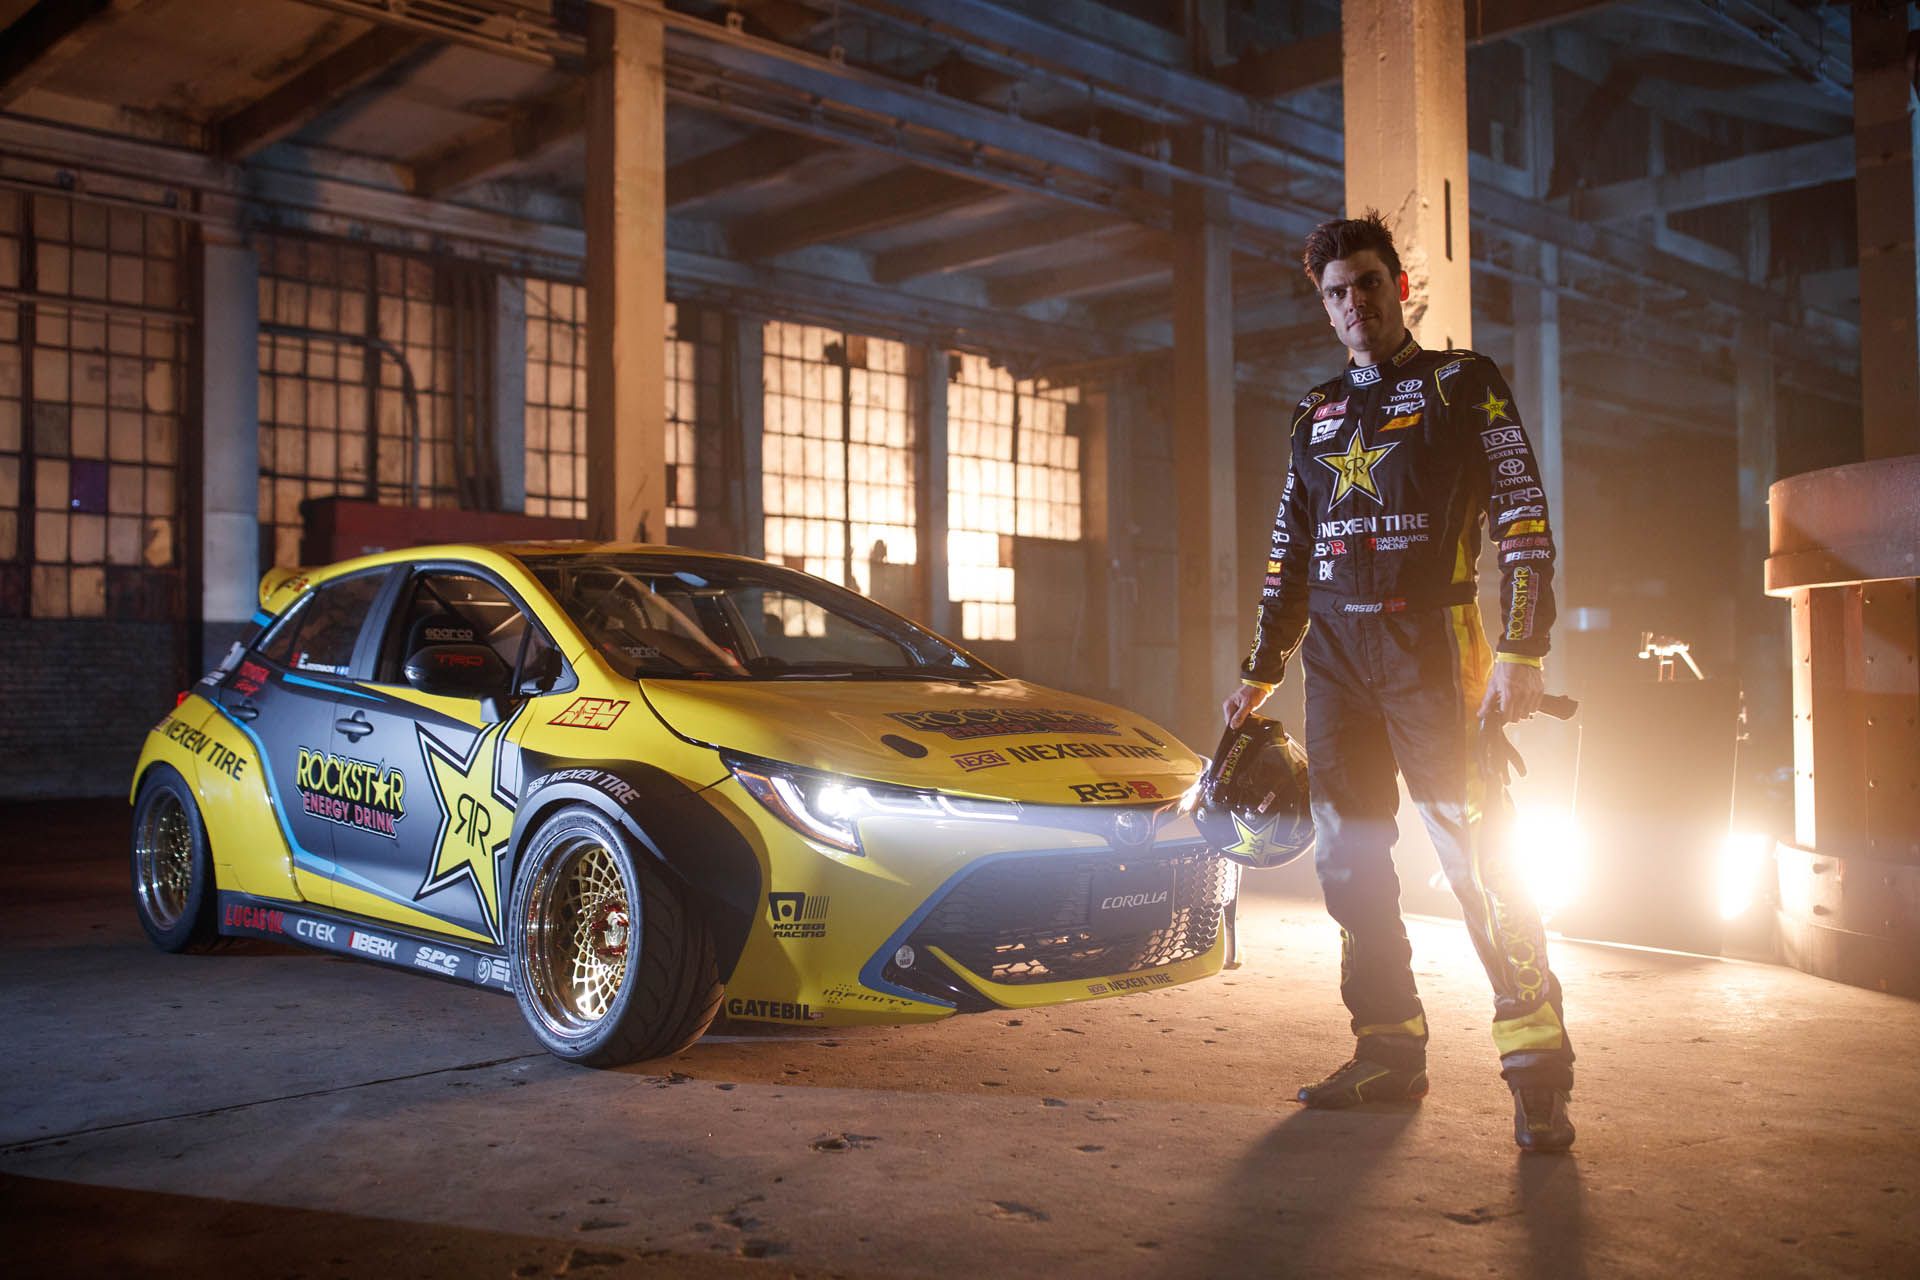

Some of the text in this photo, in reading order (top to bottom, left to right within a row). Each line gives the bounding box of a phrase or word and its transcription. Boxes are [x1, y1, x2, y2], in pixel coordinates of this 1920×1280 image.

[1351, 367, 1380, 384] NEXEN
[1390, 392, 1423, 402] TOYOTA
[1381, 399, 1425, 416] TRD
[1498, 475, 1534, 488] TOYOTA
[1491, 487, 1544, 505] TRD
[1322, 520, 1377, 539] NEXEN
[1381, 513, 1430, 533] TIRE
[1376, 534, 1429, 546] PAPADAKIS
[1376, 543, 1409, 551] RACING
[1513, 550, 1552, 562] BERK
[425, 628, 473, 642] sparco
[433, 653, 484, 666] TRD
[207, 741, 248, 781] TIRE
[1006, 742, 1107, 764] NEXEN
[1108, 743, 1171, 762] TIRE
[547, 768, 603, 783] NEXEN
[599, 773, 641, 805] TIRE
[303, 791, 396, 833] ENERGY DRINK
[1102, 890, 1168, 910] COROLLA
[224, 904, 285, 934] LUCAS OIL
[773, 923, 825, 931] MOTEGI
[296, 919, 336, 943] CTEK
[773, 930, 826, 938] RACING
[359, 931, 399, 960] BERK
[416, 946, 460, 968] SPC
[1107, 979, 1147, 993] NEXEN
[1145, 973, 1173, 985] TIRE
[728, 998, 815, 1020] GATEBIL
